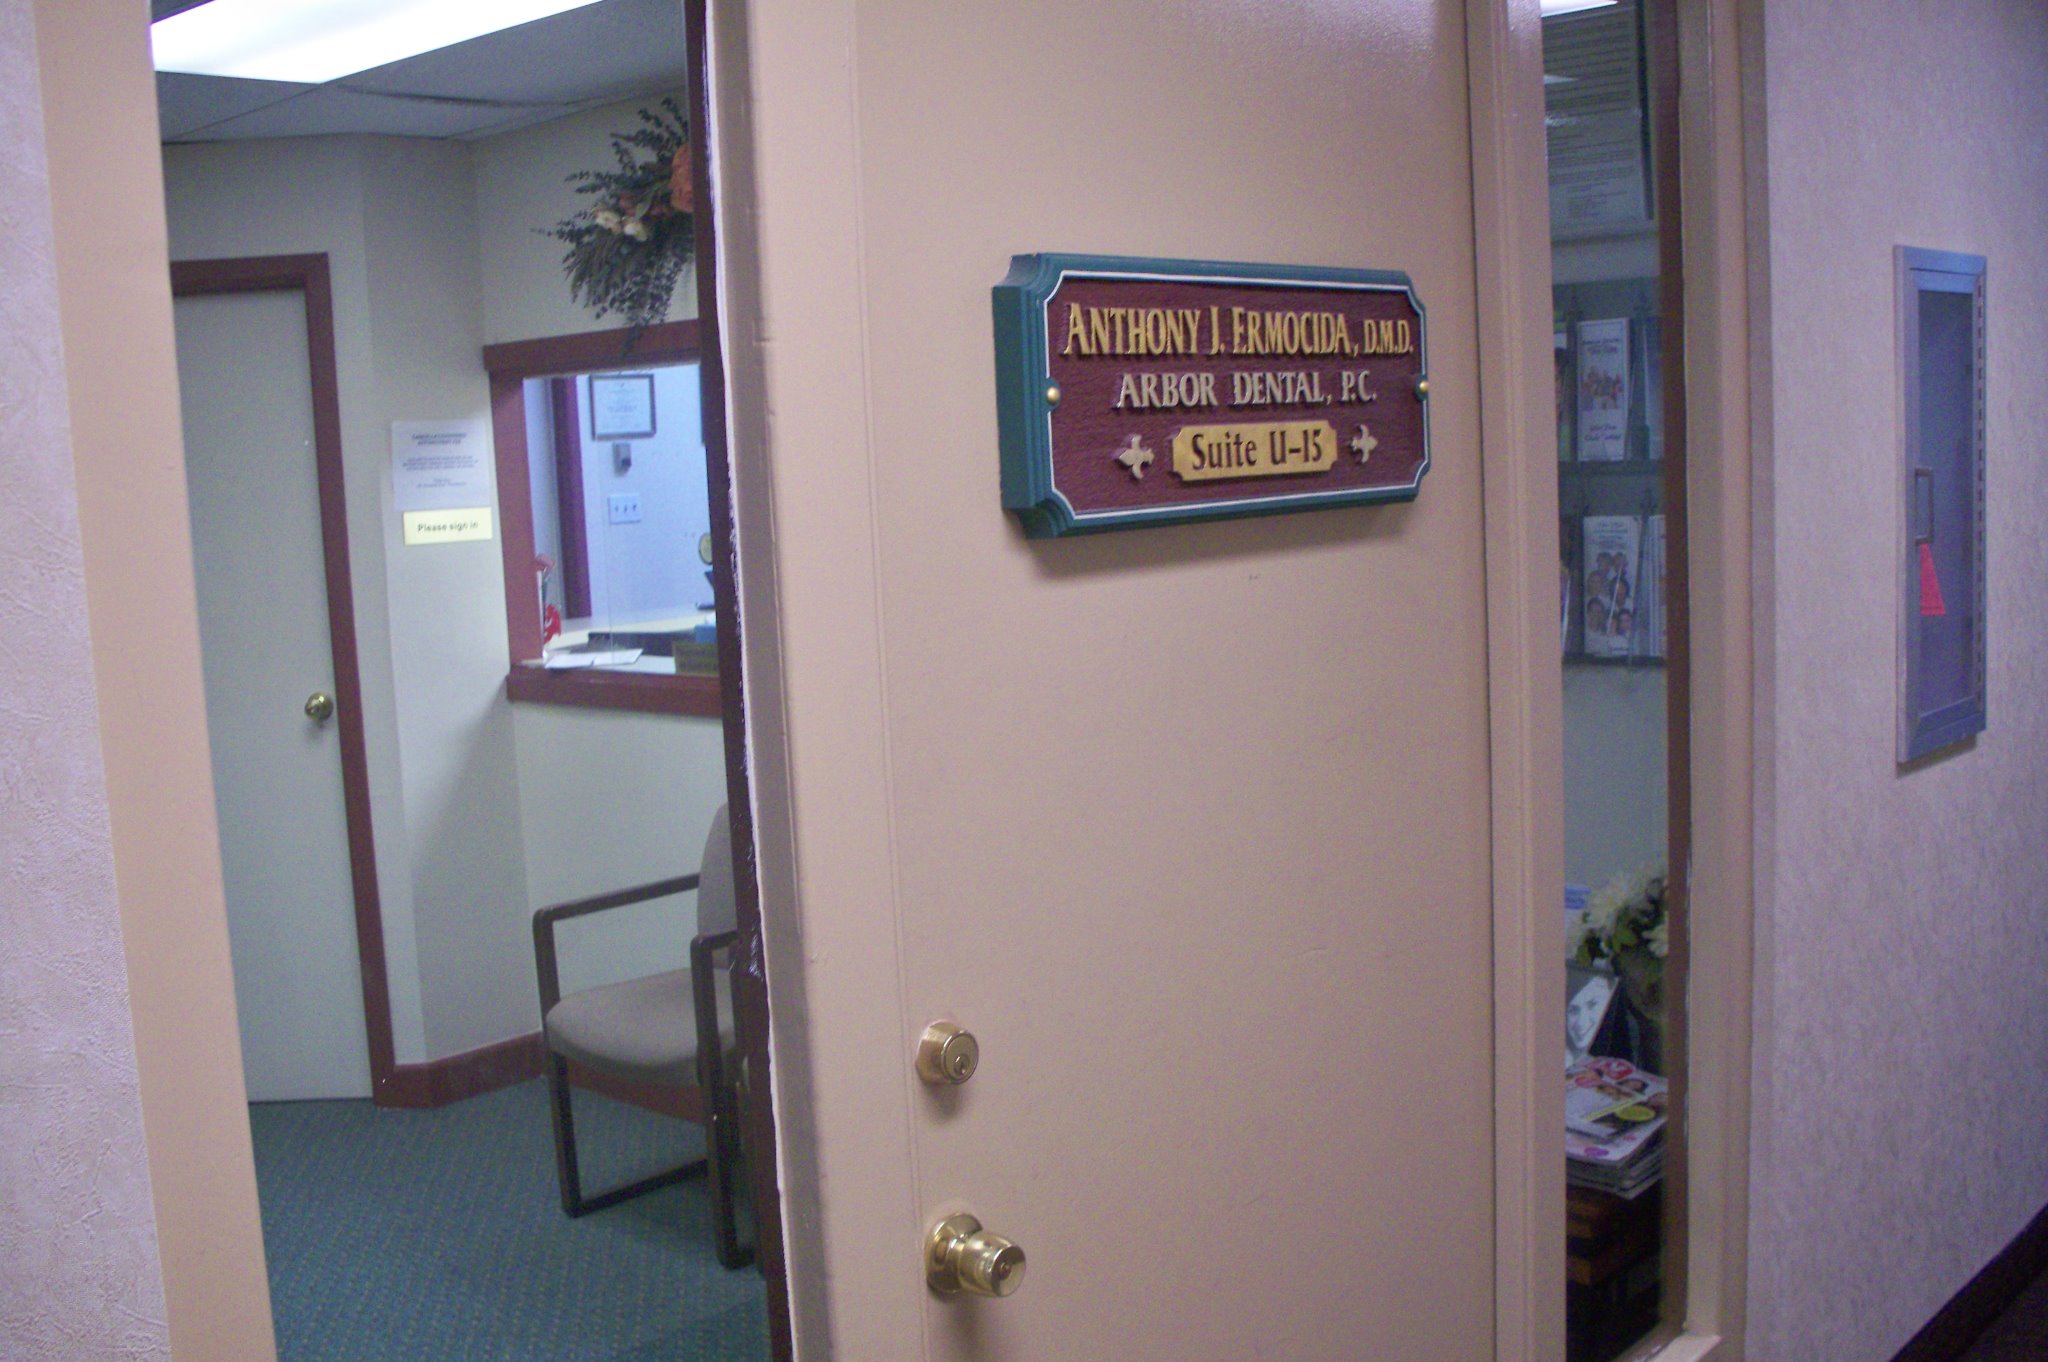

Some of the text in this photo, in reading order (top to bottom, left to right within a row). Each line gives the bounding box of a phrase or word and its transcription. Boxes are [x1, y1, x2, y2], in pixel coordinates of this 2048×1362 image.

[1064, 302, 1414, 358] ANTHONY J. ERMOCIDA, D.M.D.
[1116, 370, 1378, 408] ARBOR DENTAL, P.C.
[1191, 428, 1323, 471] Suite U-15
[417, 521, 478, 533] Please sign in
